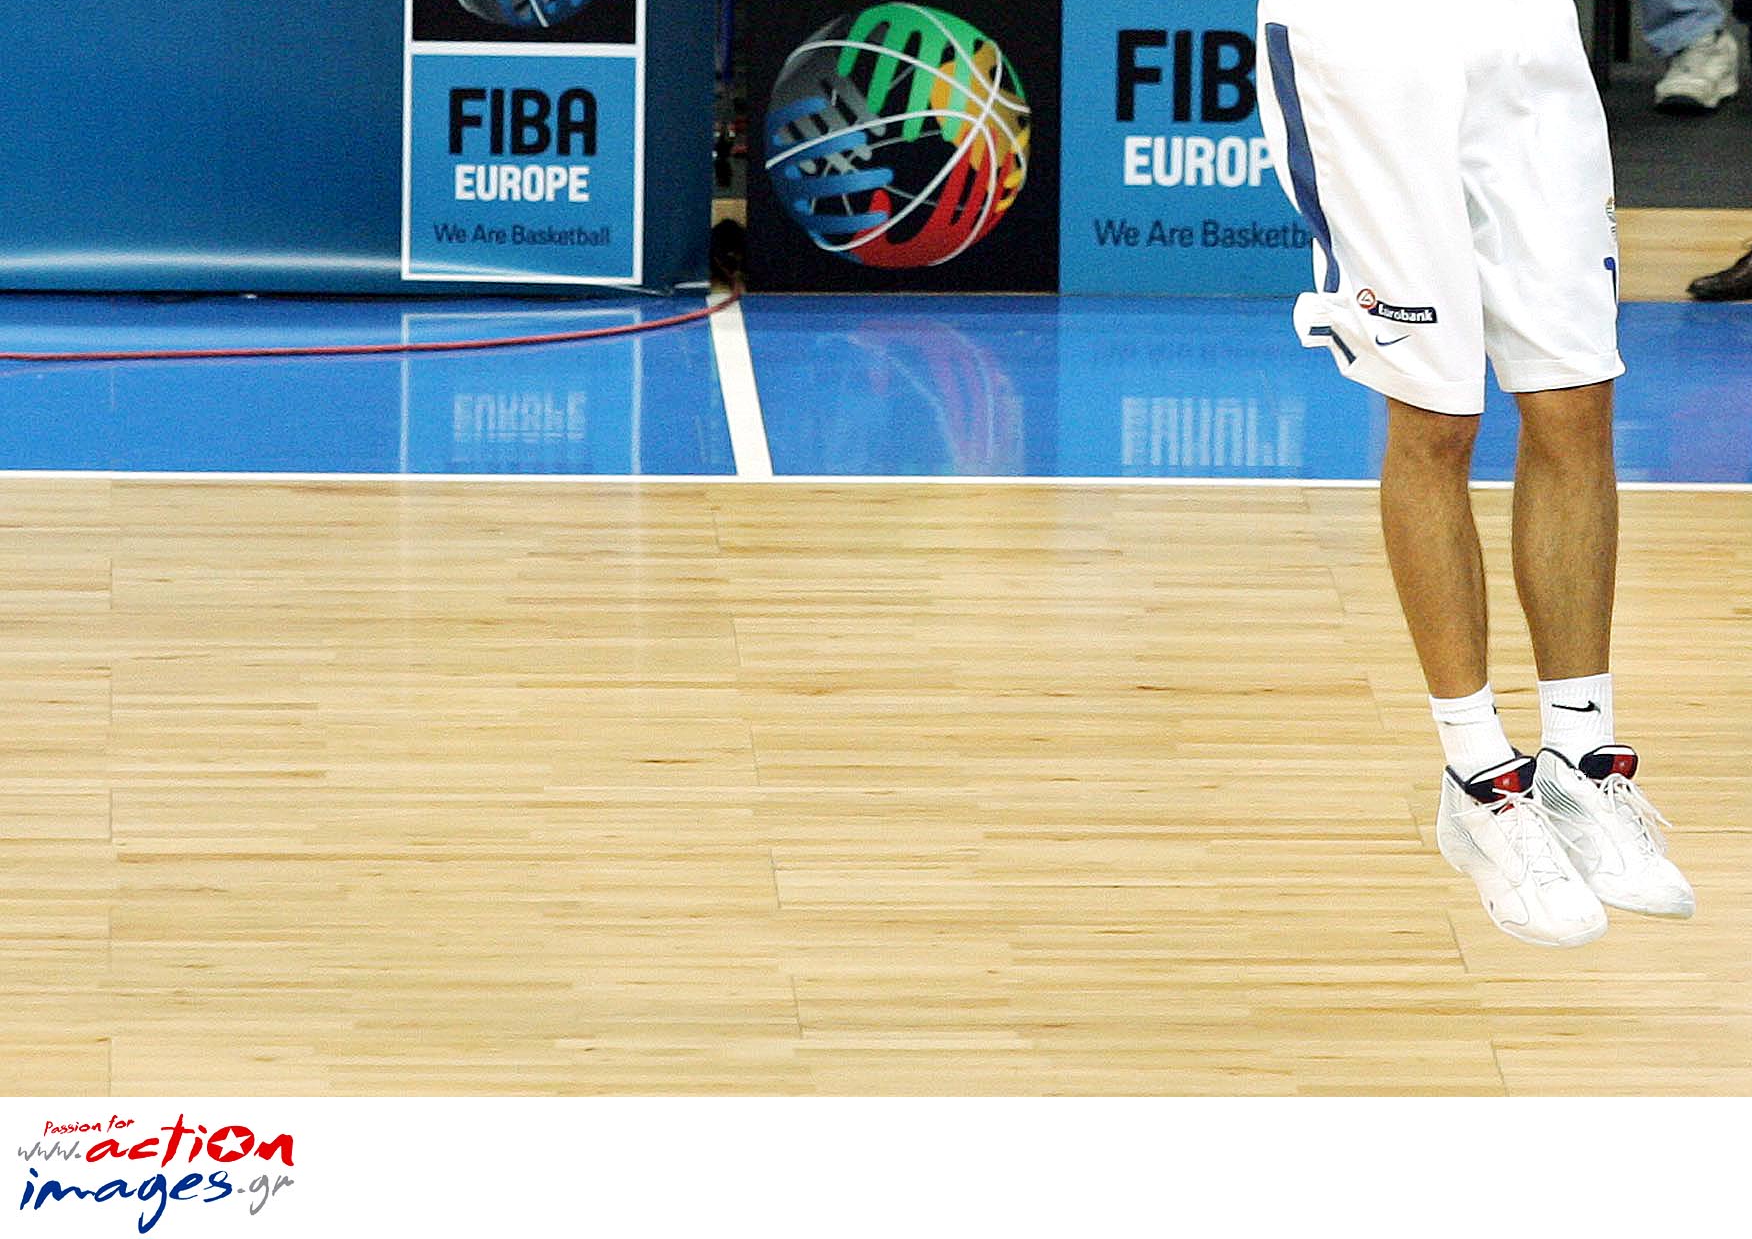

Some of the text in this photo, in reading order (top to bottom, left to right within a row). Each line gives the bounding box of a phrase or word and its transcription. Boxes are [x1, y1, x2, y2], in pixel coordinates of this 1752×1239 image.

[1116, 29, 1256, 122] FIB
[449, 88, 598, 156] FIBA
[454, 164, 590, 202] EUROPE
[1124, 135, 1275, 187] EUROP
[433, 224, 611, 246] We Are Basketball
[1095, 219, 1312, 249] We Are Basketb
